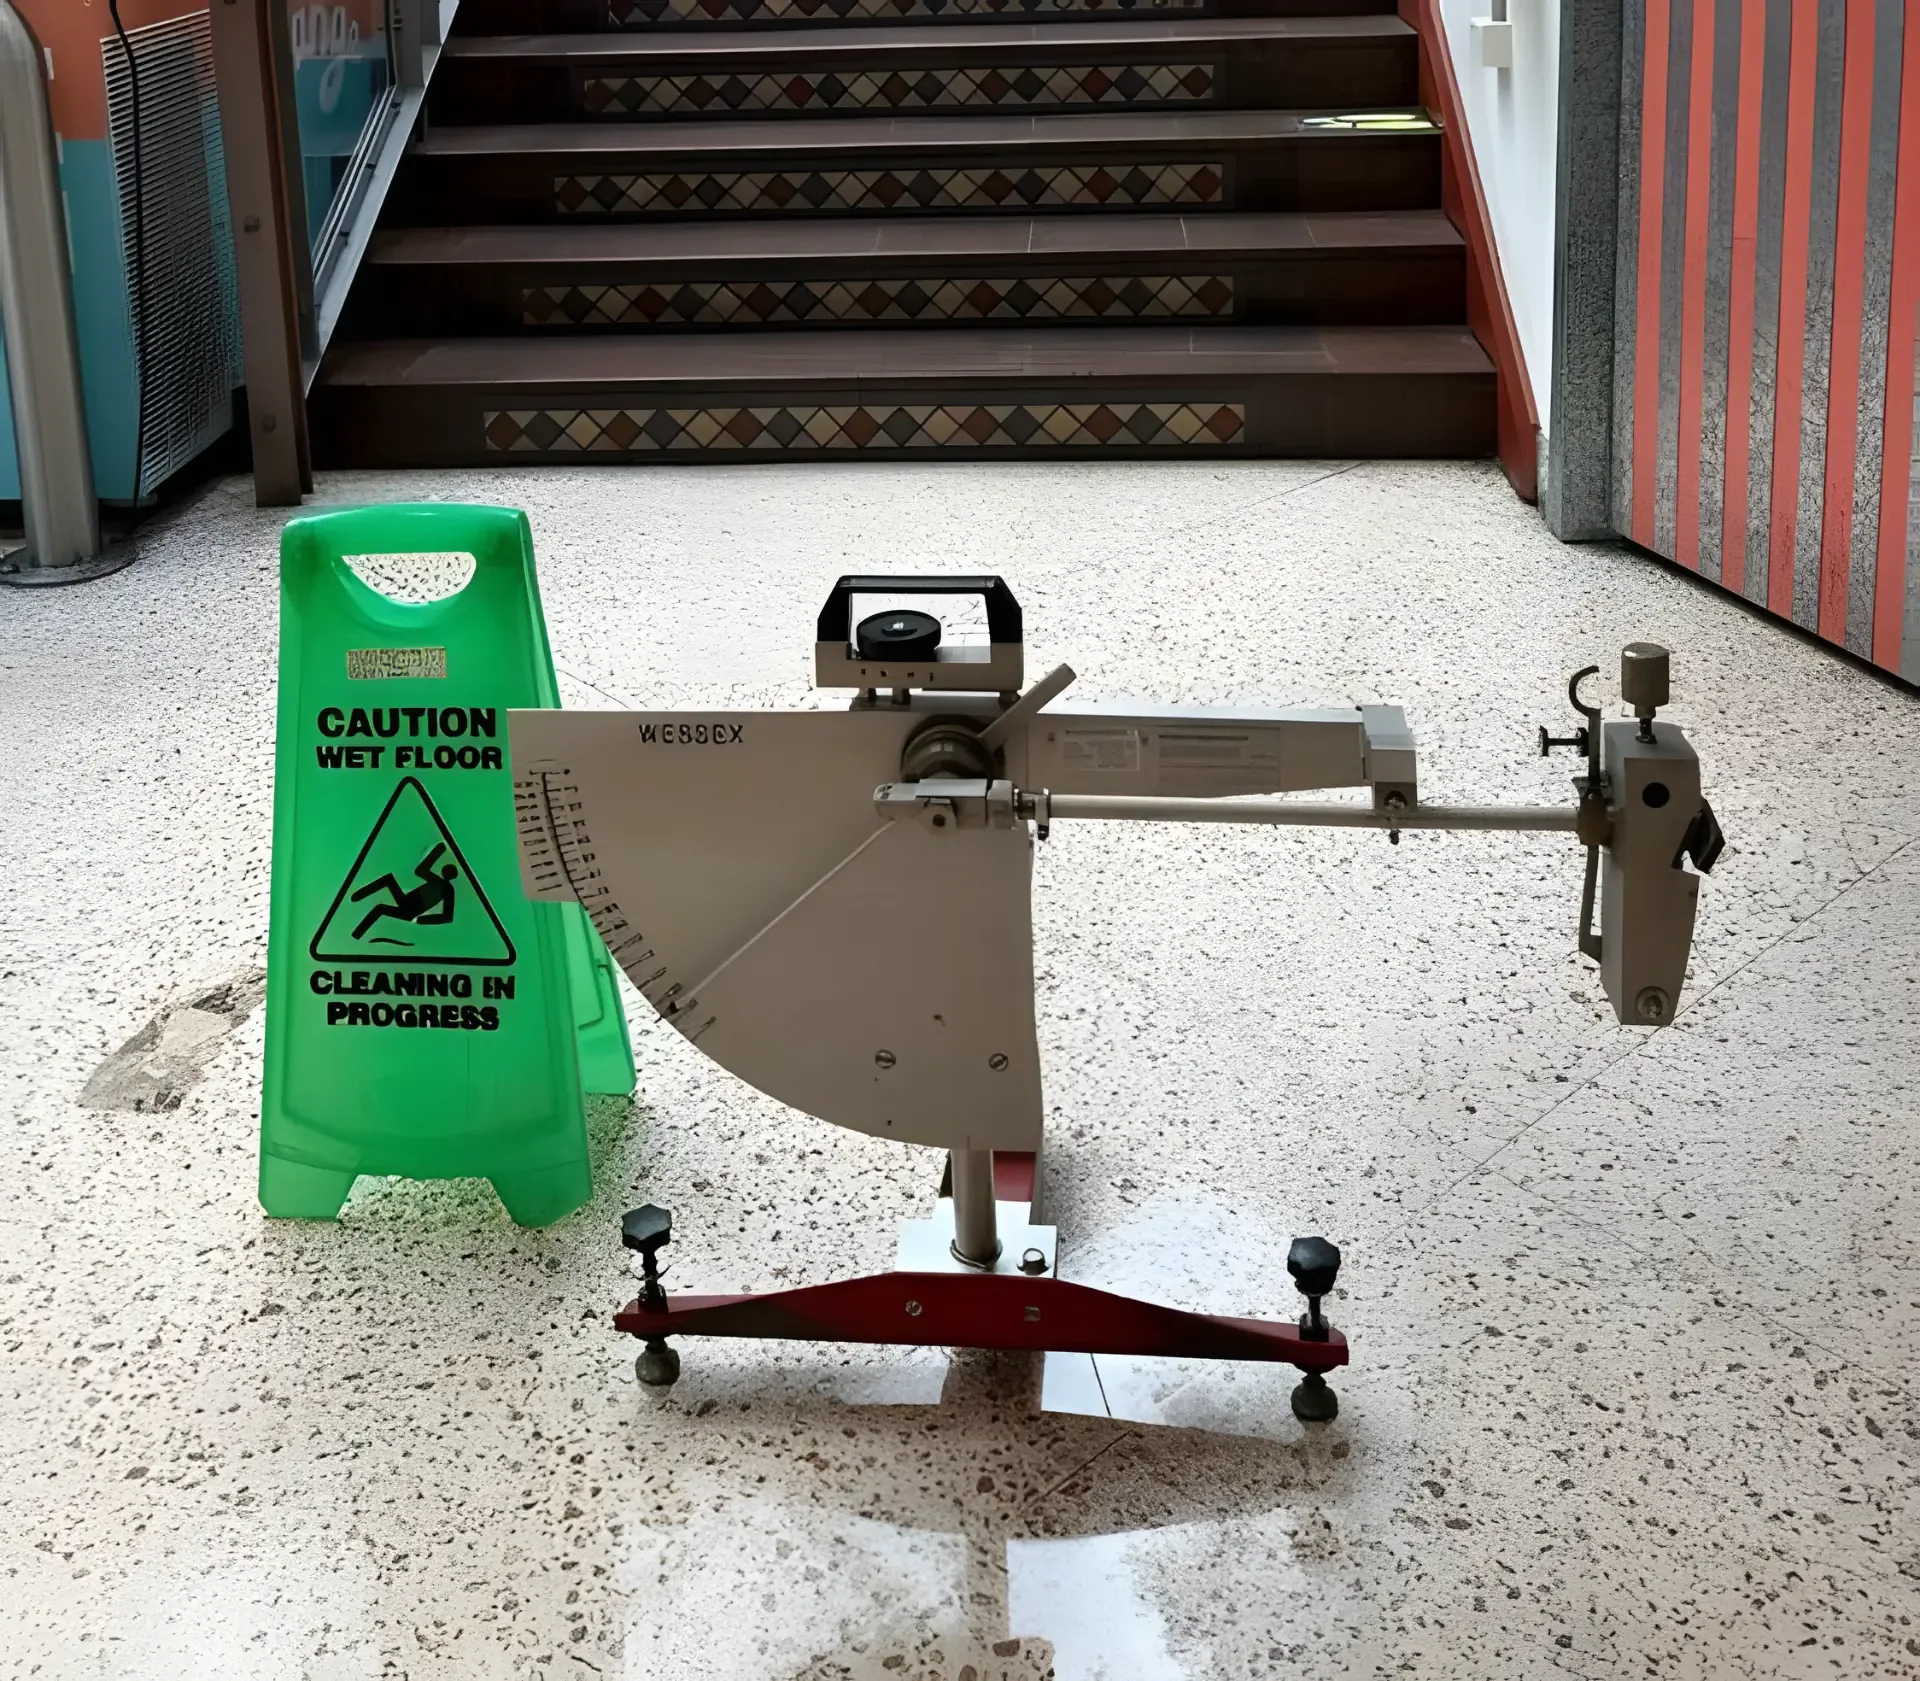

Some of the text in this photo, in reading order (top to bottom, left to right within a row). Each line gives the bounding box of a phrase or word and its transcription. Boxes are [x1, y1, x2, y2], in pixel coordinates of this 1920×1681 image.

[317, 706, 497, 738] CAUTION
[316, 745, 503, 770] WET FLOOR
[309, 970, 516, 1000] CLEANING IN
[327, 1001, 500, 1031] PROGRESS
